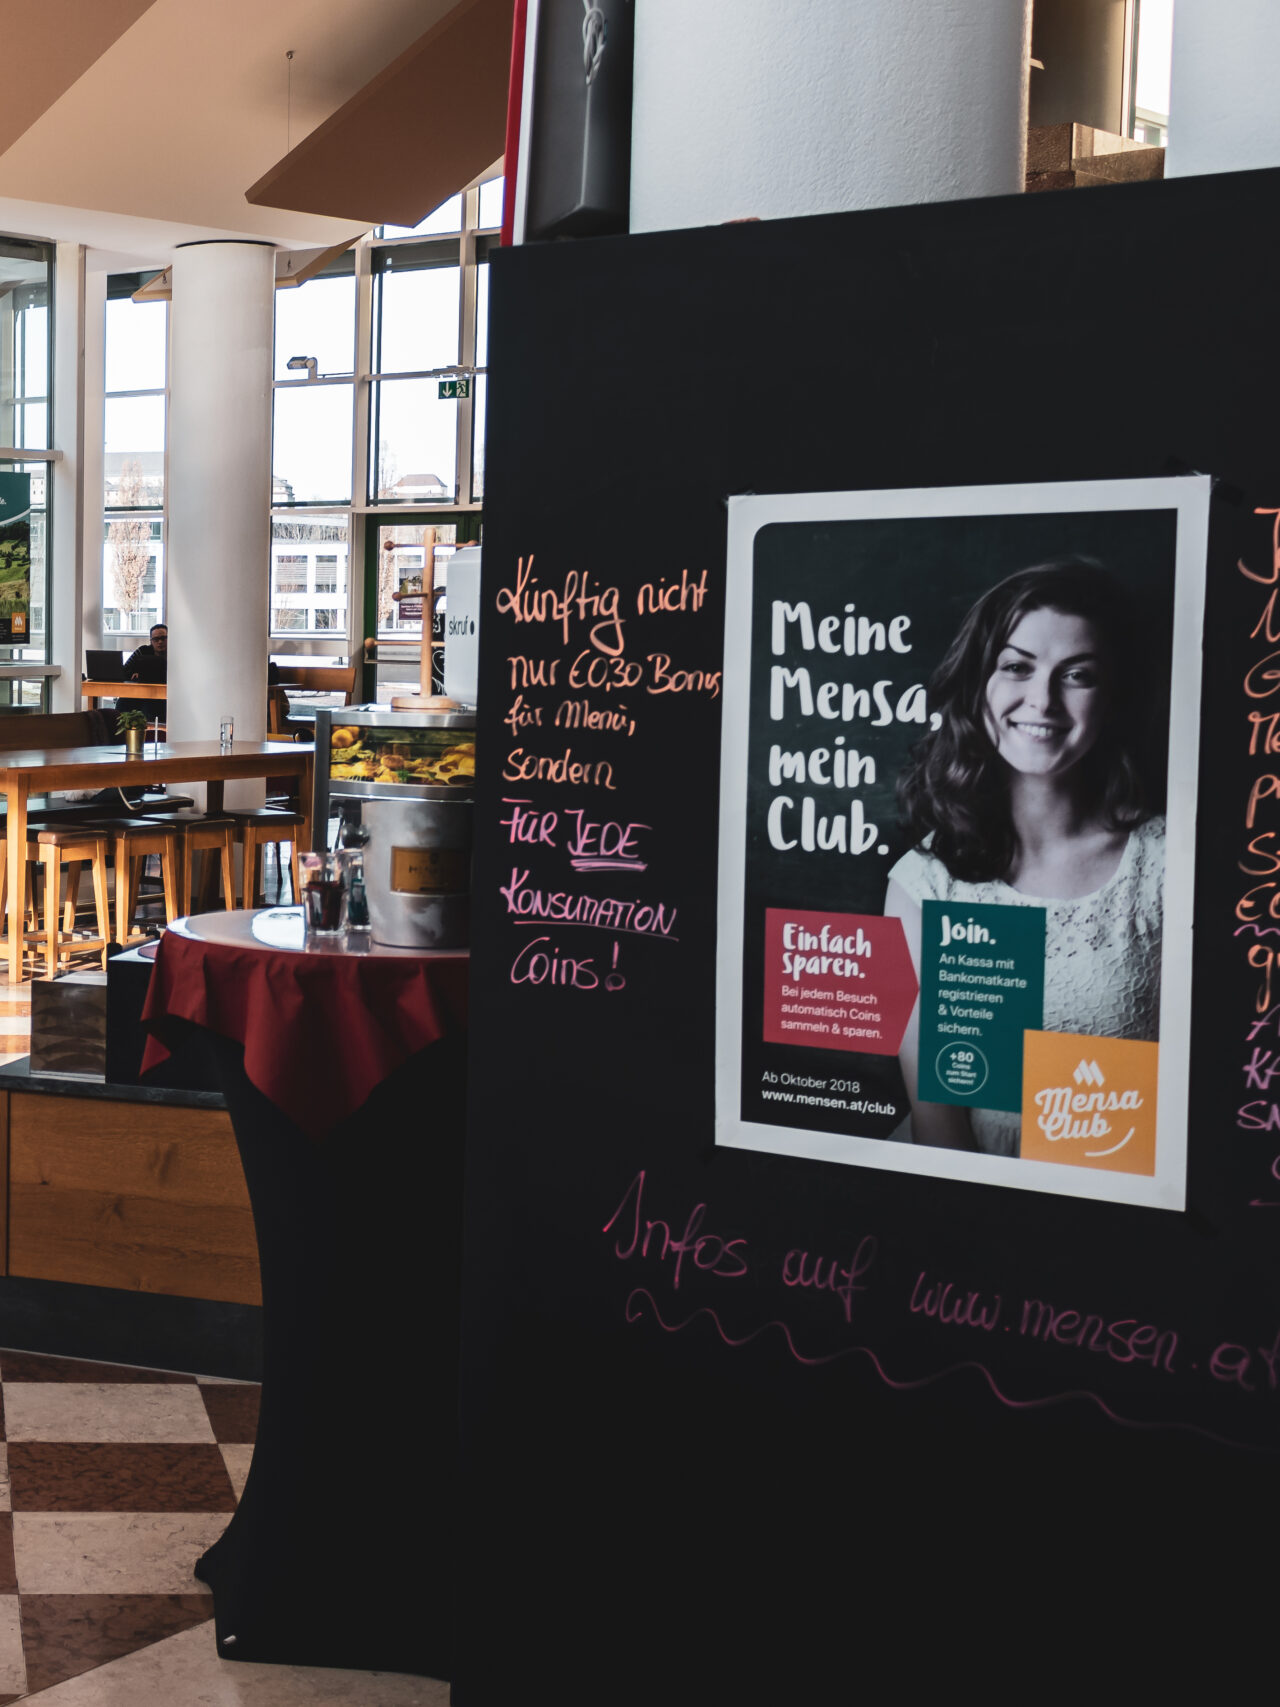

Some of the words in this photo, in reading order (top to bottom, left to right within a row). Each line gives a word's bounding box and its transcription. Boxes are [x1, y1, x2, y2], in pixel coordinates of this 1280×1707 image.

[637, 568, 710, 616] nicht
[448, 615, 469, 636] skruf
[771, 600, 913, 657] Meine
[506, 655, 561, 691] nur
[569, 649, 643, 692] €0,30
[770, 665, 943, 732] Mensa,
[503, 694, 543, 737] für
[554, 699, 636, 737] Menü,
[768, 736, 876, 789] mein
[564, 808, 653, 858] JEDE
[767, 795, 889, 856] Club.
[782, 922, 872, 958] Einfach
[939, 914, 997, 947] Join.
[939, 953, 956, 965] An
[958, 954, 993, 968] Kassa
[995, 958, 1015, 970] mit
[938, 969, 1027, 989] Bankomatkarte
[781, 985, 799, 997] Bei
[800, 987, 834, 1001] jedem
[836, 990, 878, 1005] Besuch
[938, 988, 1004, 1004] registrieren
[781, 1003, 847, 1018] automatisch
[849, 1008, 881, 1022] Coins
[937, 1004, 948, 1016] &
[949, 1005, 994, 1020] Vorteile
[780, 1019, 829, 1033] sammeln
[831, 1023, 841, 1035] &
[842, 1025, 883, 1040] sparen.
[937, 1022, 983, 1037] sichern.
[949, 1050, 975, 1063] +80
[951, 1061, 971, 1070] Coins
[762, 1071, 778, 1084] Ab
[780, 1072, 827, 1089] Oktober
[829, 1079, 861, 1094] 2018
[960, 1070, 977, 1078] Start
[761, 1090, 896, 1116] www.mensen.at/club
[1034, 1087, 1144, 1115] Mensa
[1037, 1111, 1112, 1141] Club
[603, 1170, 748, 1290] Infos
[782, 1235, 879, 1323] auf
